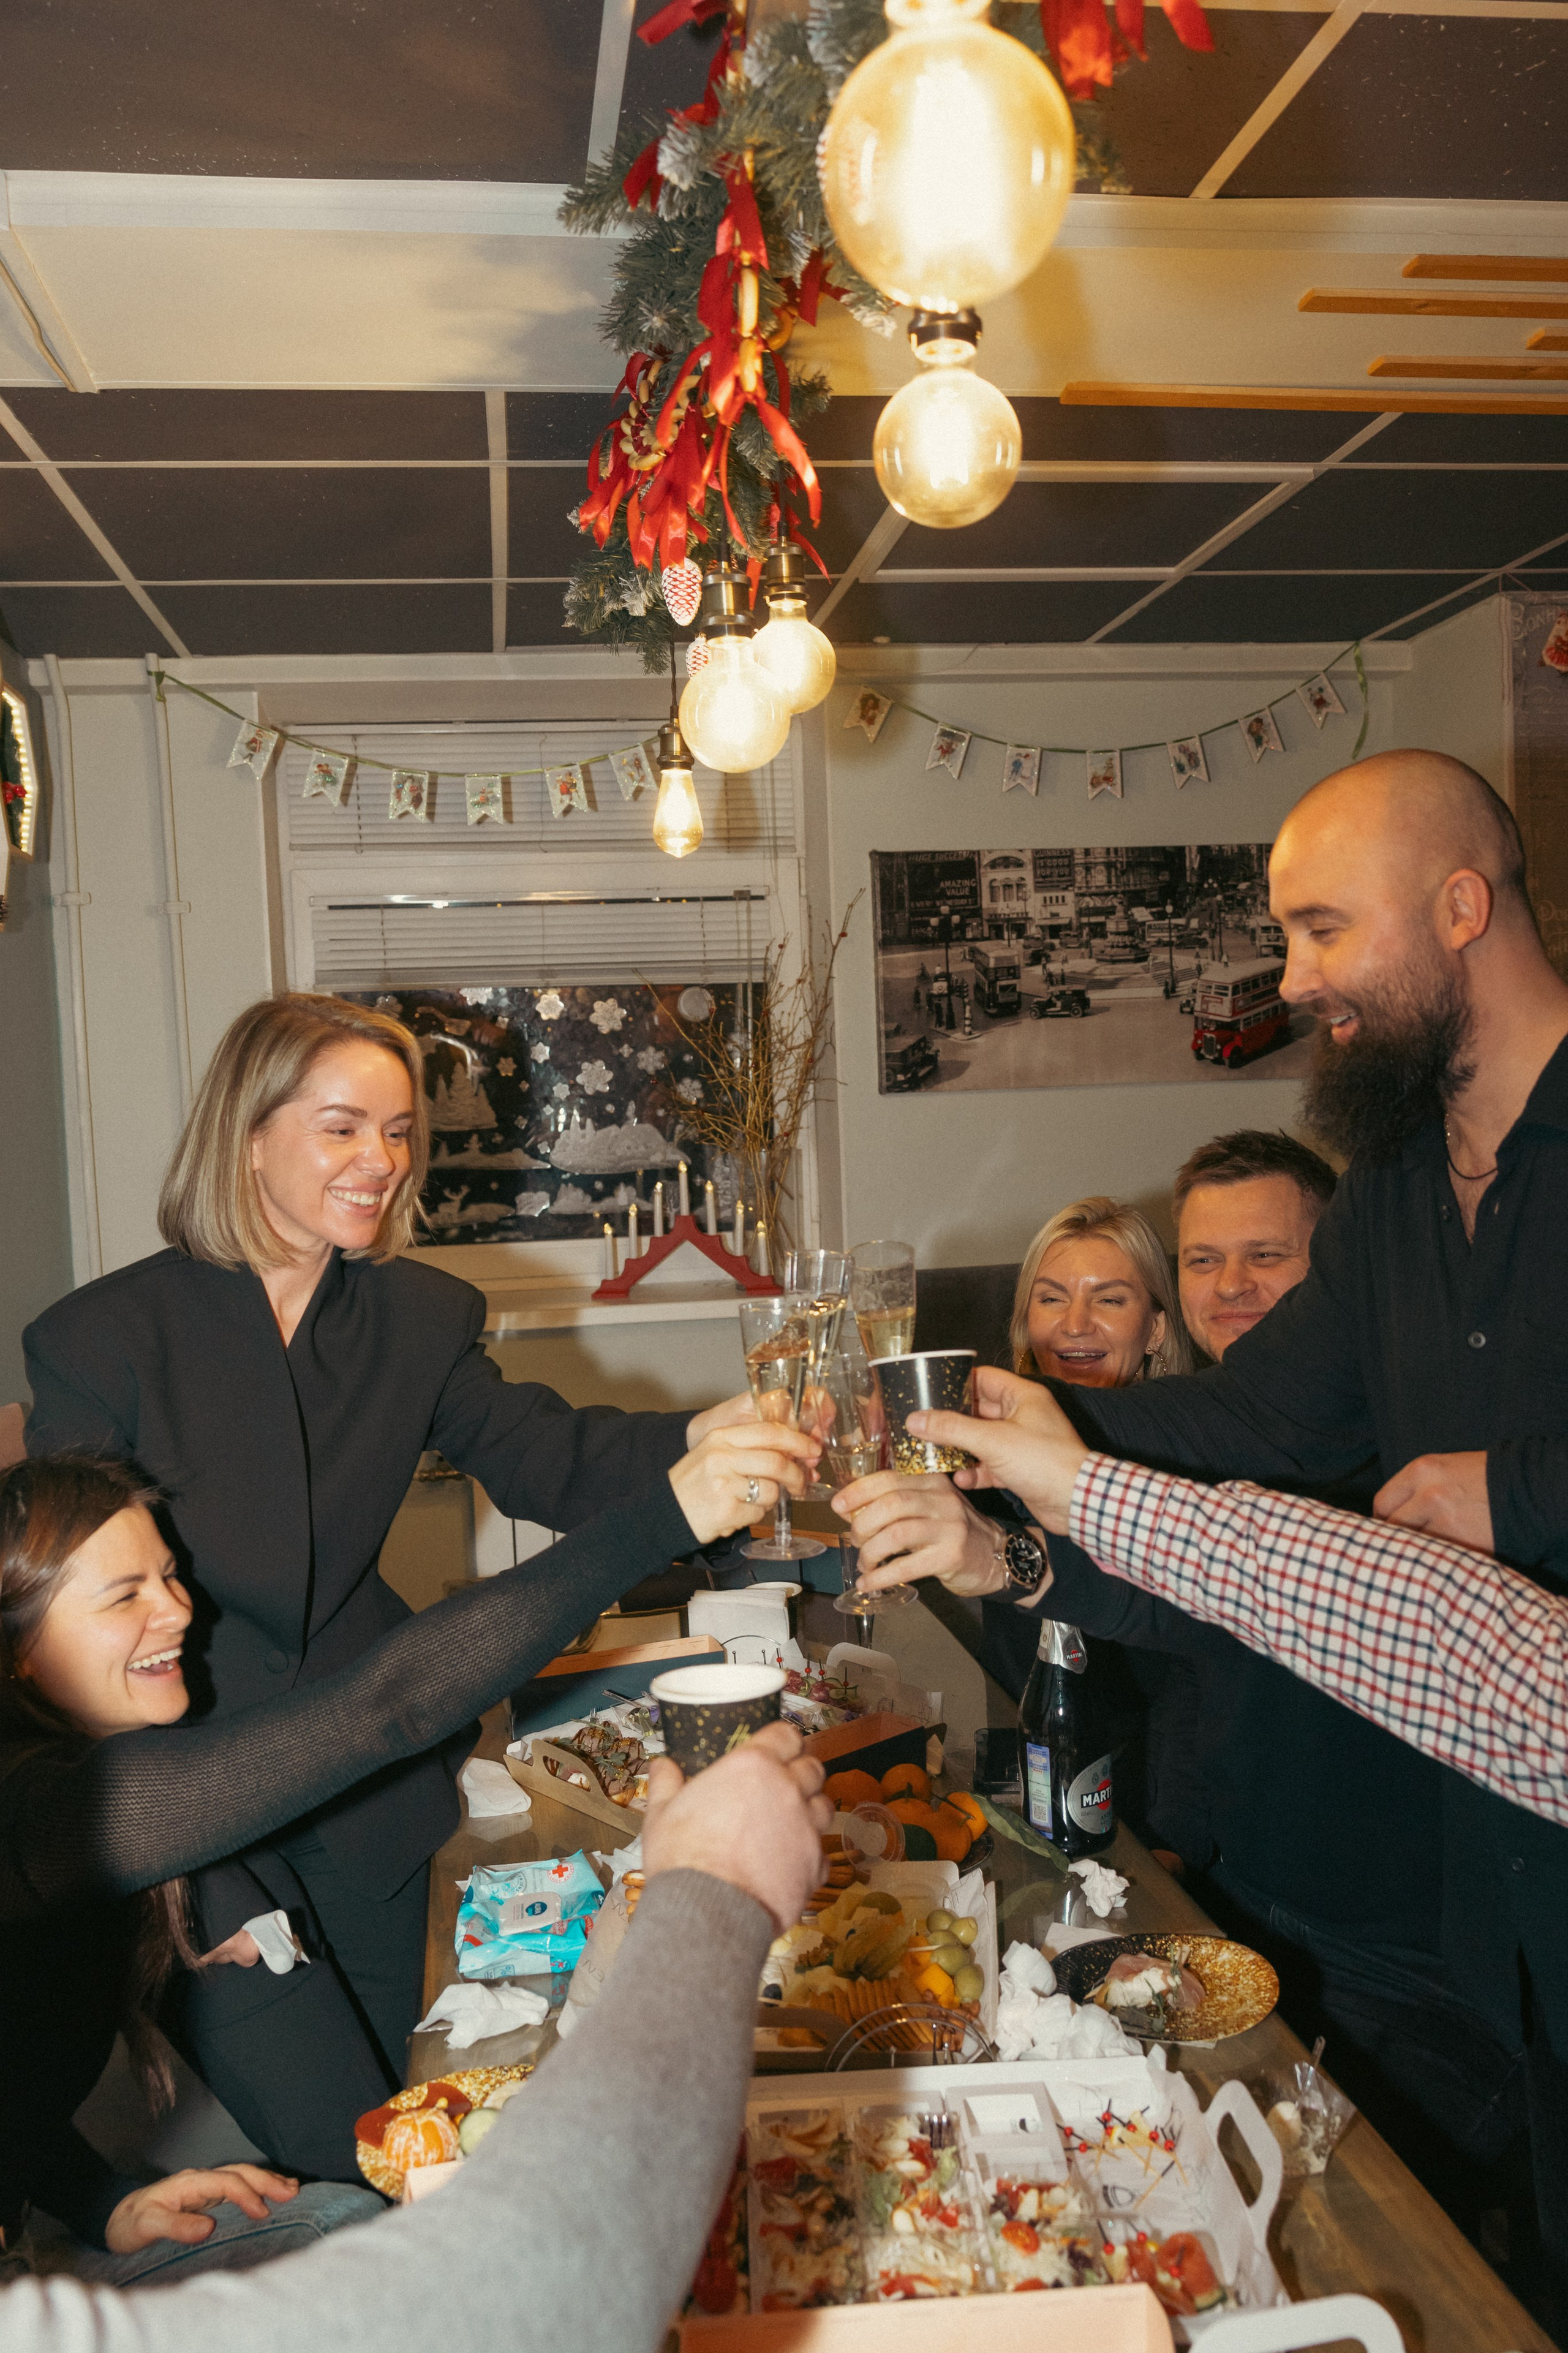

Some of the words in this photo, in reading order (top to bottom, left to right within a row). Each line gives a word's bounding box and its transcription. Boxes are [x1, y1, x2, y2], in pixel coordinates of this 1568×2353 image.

[908, 853, 932, 861] HUGE
[939, 878, 976, 888] AMAZING
[946, 887, 970, 896] VALUE
[1082, 1785, 1112, 1807] MARTI
